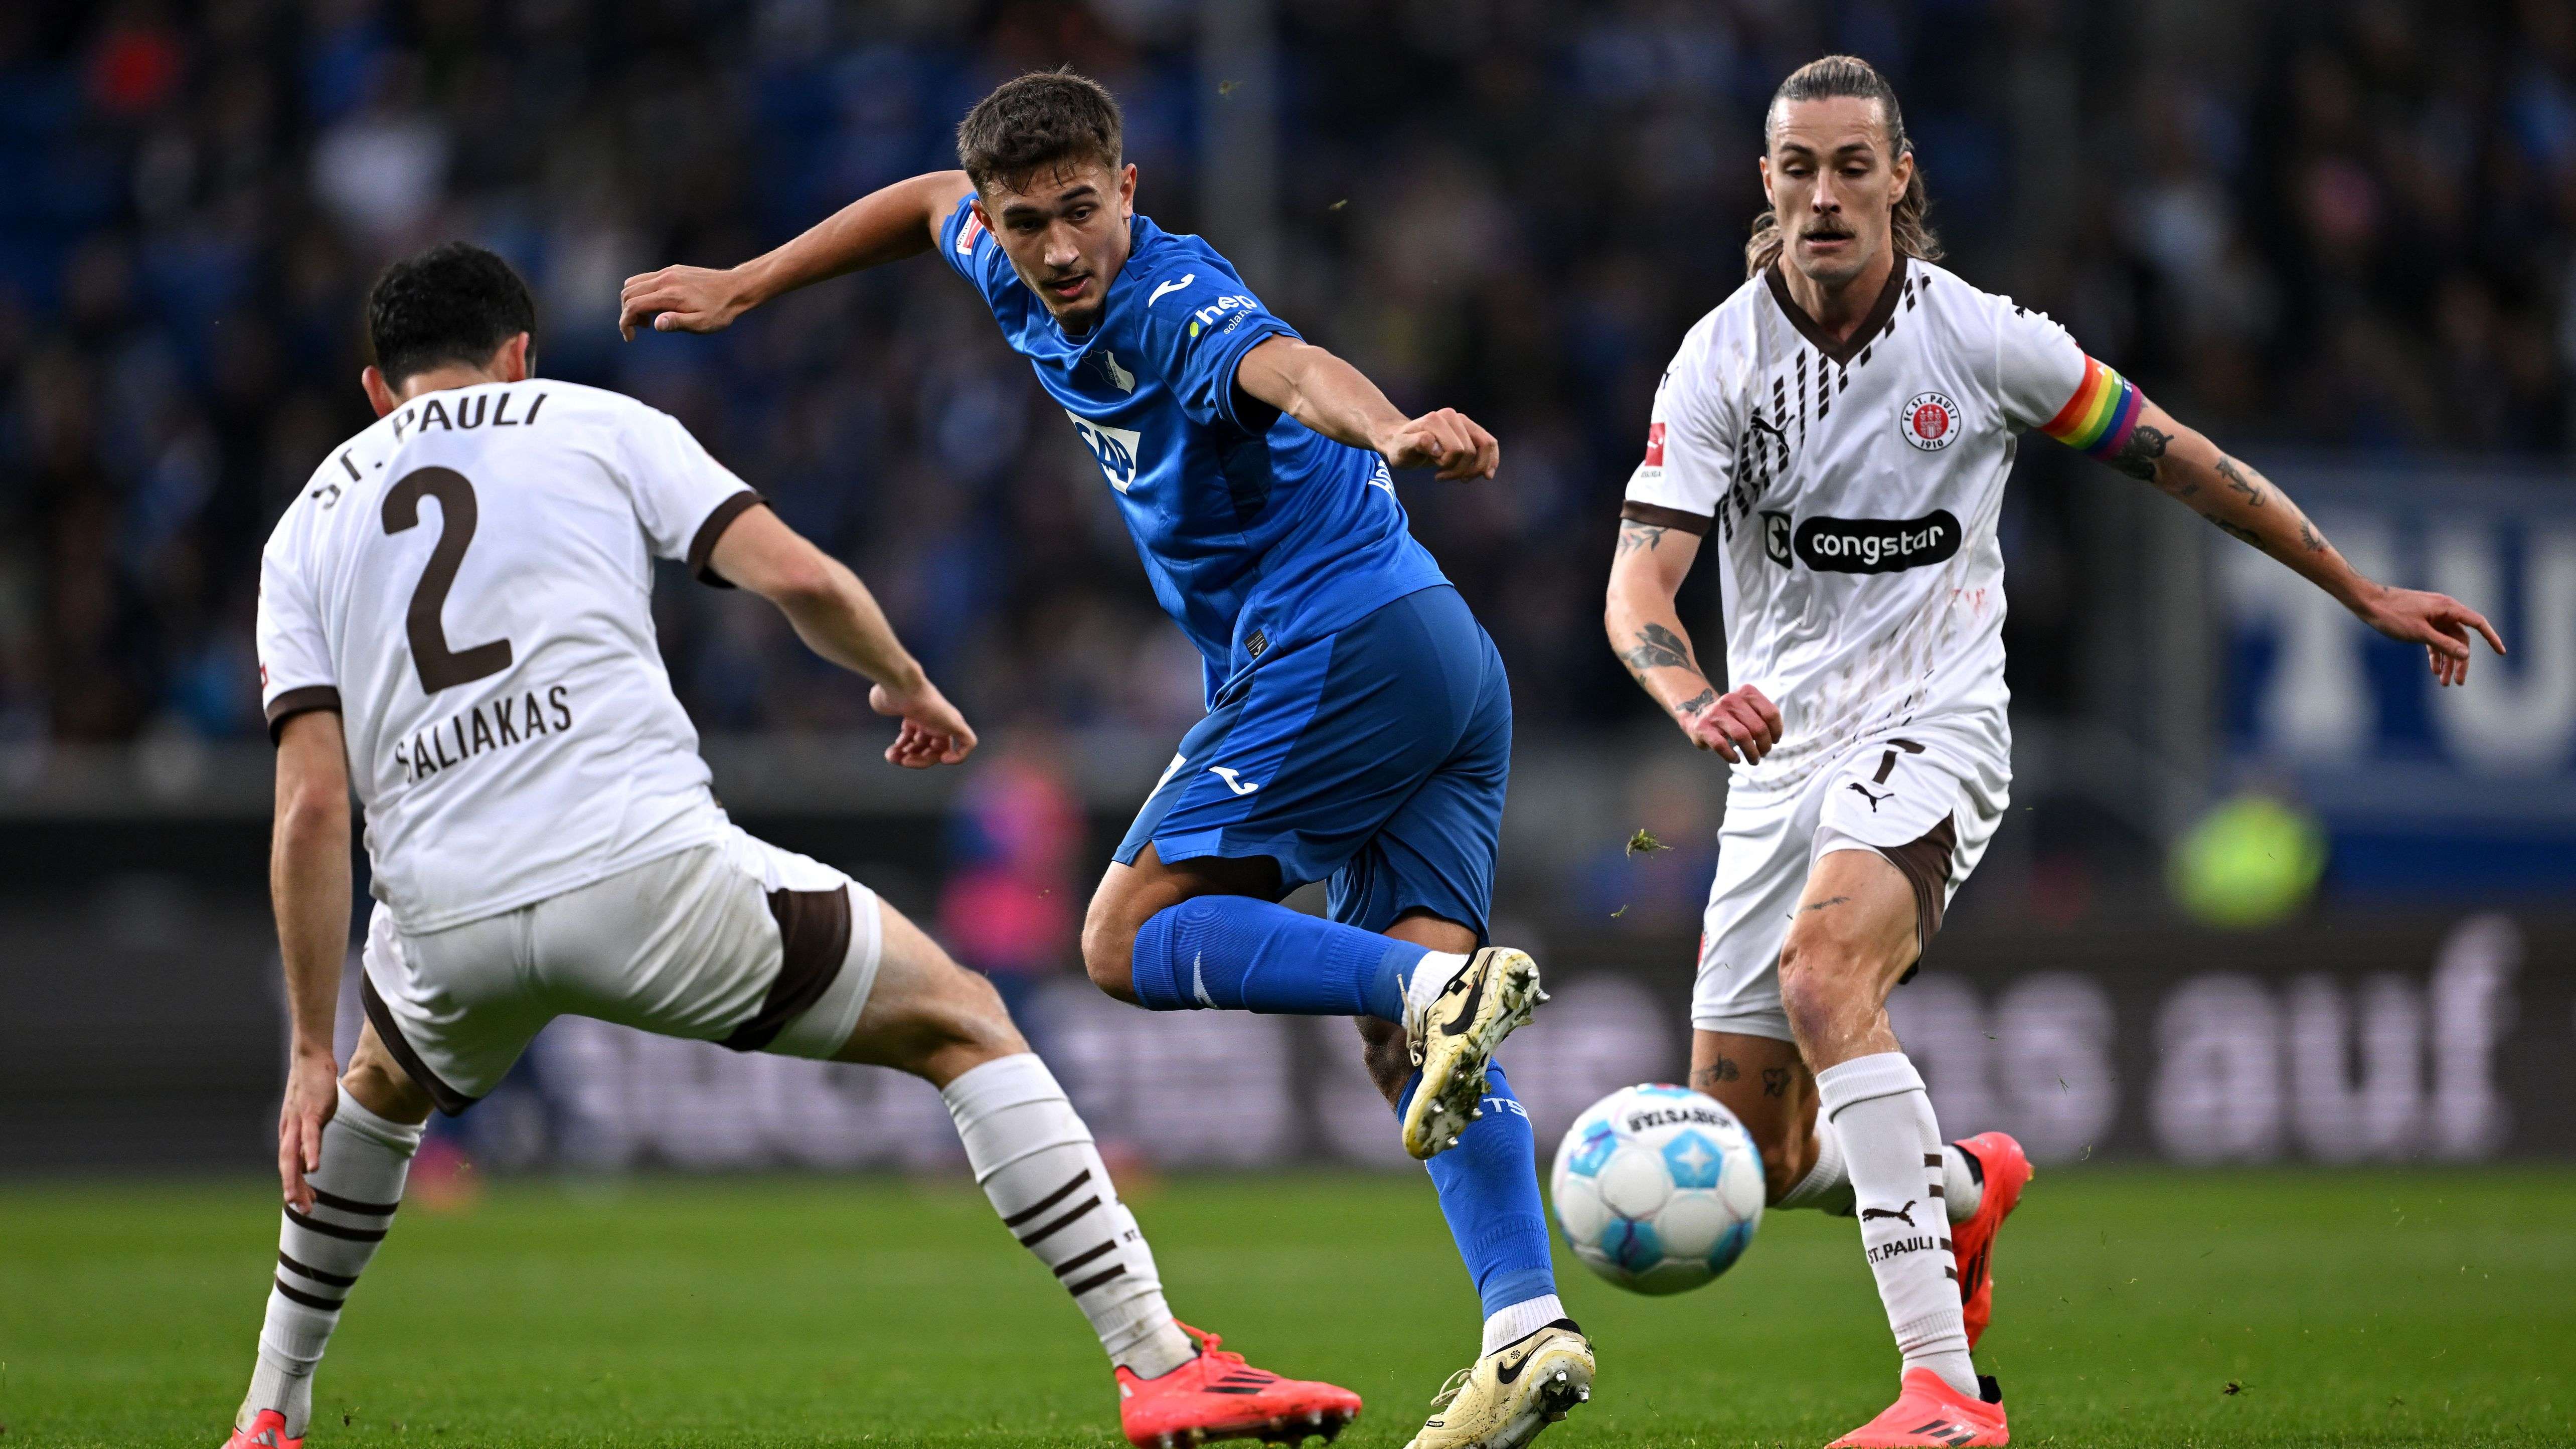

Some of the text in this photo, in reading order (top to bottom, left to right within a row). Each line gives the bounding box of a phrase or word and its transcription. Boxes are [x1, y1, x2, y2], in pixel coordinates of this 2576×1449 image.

[1195, 295, 1257, 325] hep
[392, 392, 547, 444] PAULI
[1904, 395, 1958, 421] FC ST. PAULI
[1074, 421, 1135, 484] SAP
[1920, 439, 1944, 448] 1910
[1812, 525, 1944, 565] congstar
[381, 465, 513, 696] 2
[395, 686, 572, 783] SALIAKAS
[1867, 1236, 1934, 1264] ST.PAULI
